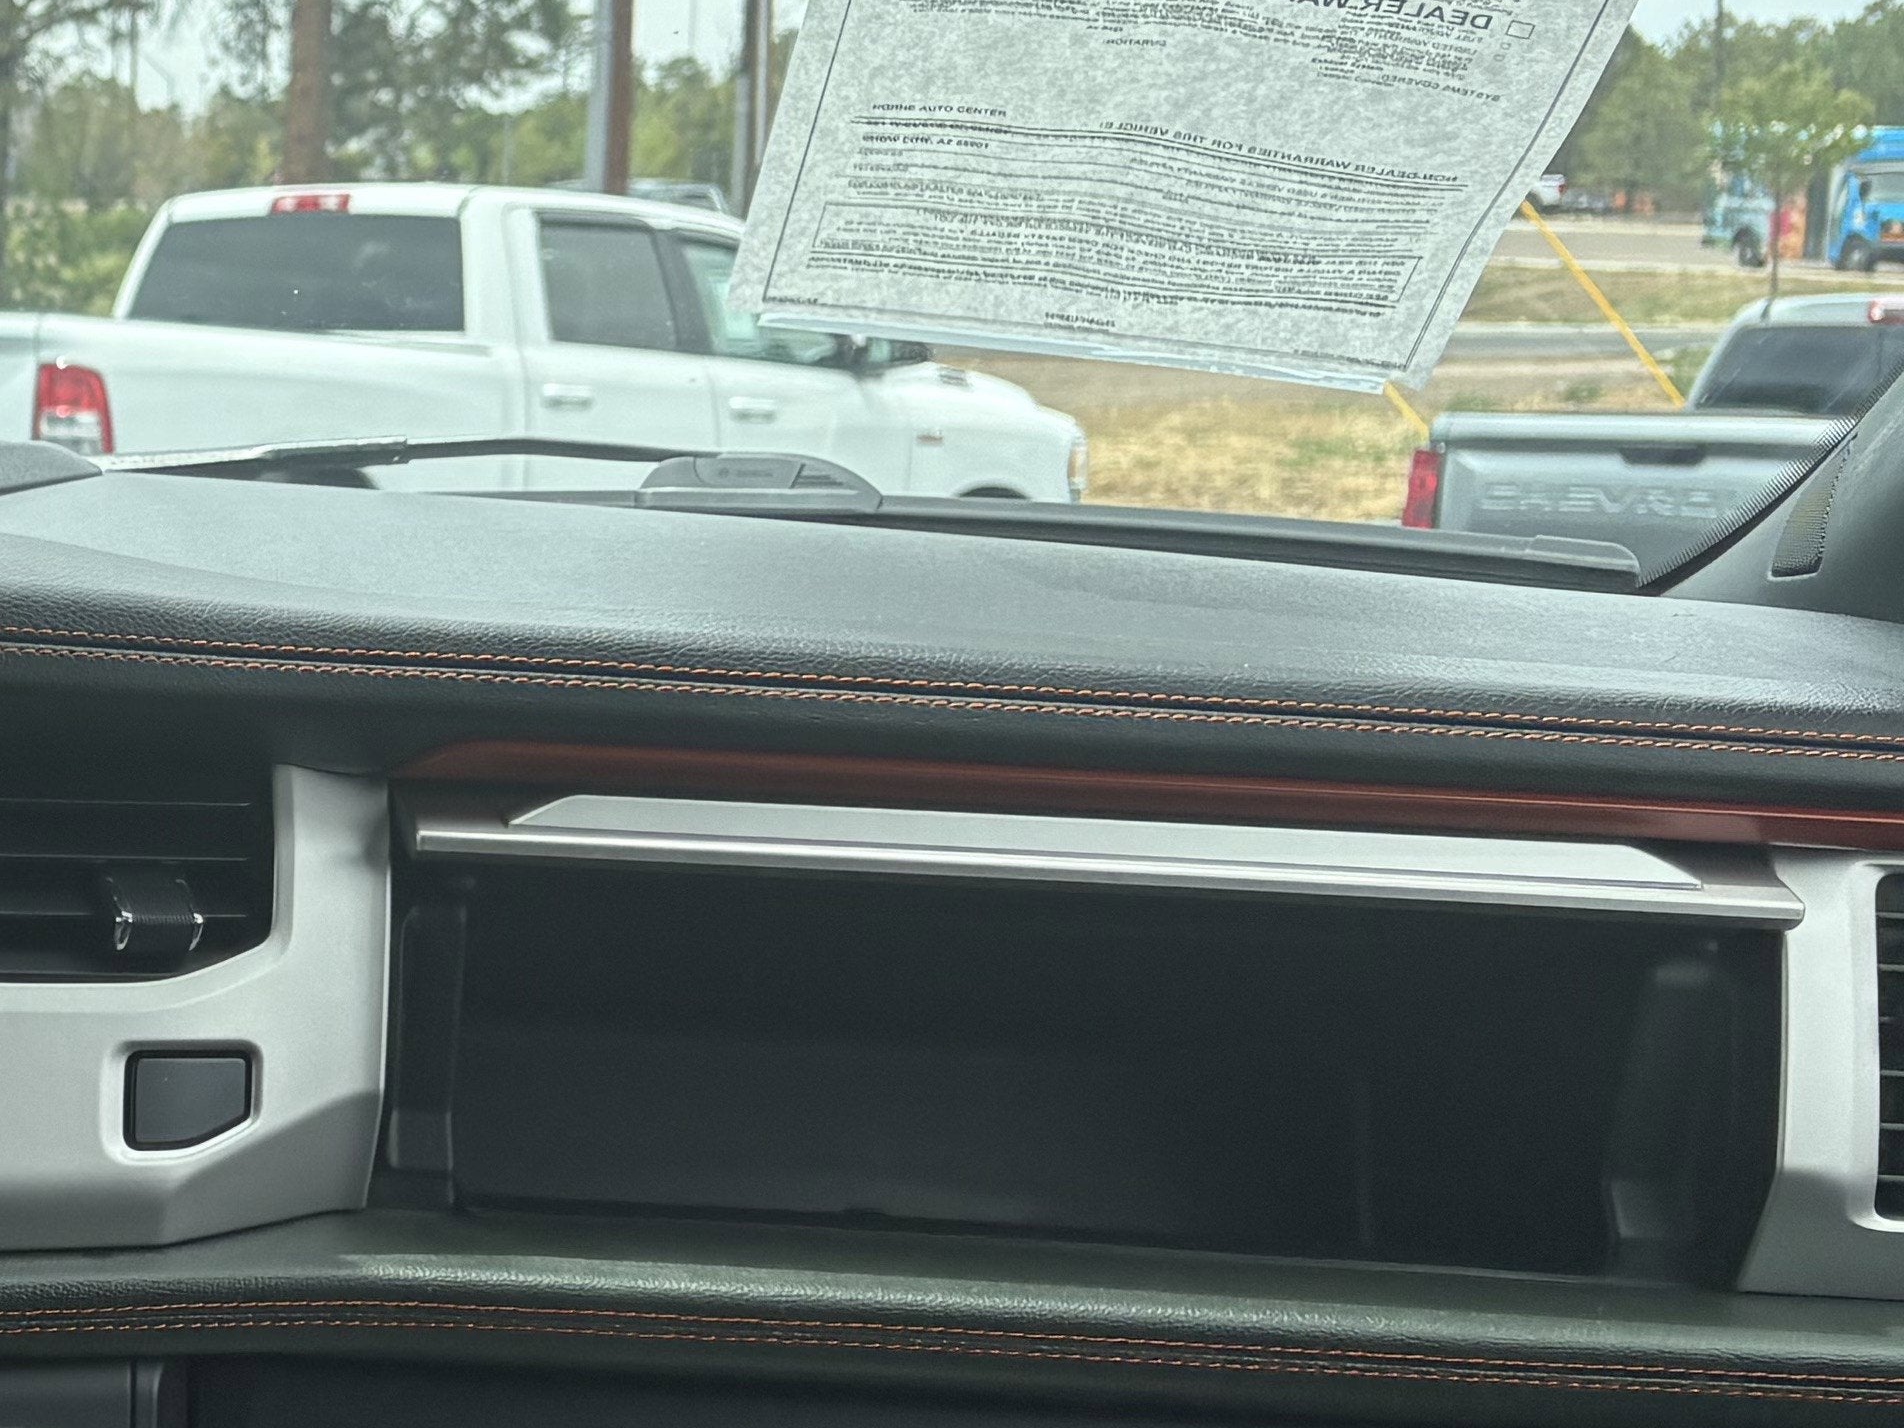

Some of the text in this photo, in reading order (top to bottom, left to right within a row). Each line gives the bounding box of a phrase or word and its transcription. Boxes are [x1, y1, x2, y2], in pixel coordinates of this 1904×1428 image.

[919, 104, 954, 113] AUTO
[957, 105, 1008, 118] CENTER
[1482, 484, 1734, 520] CHEVRO
